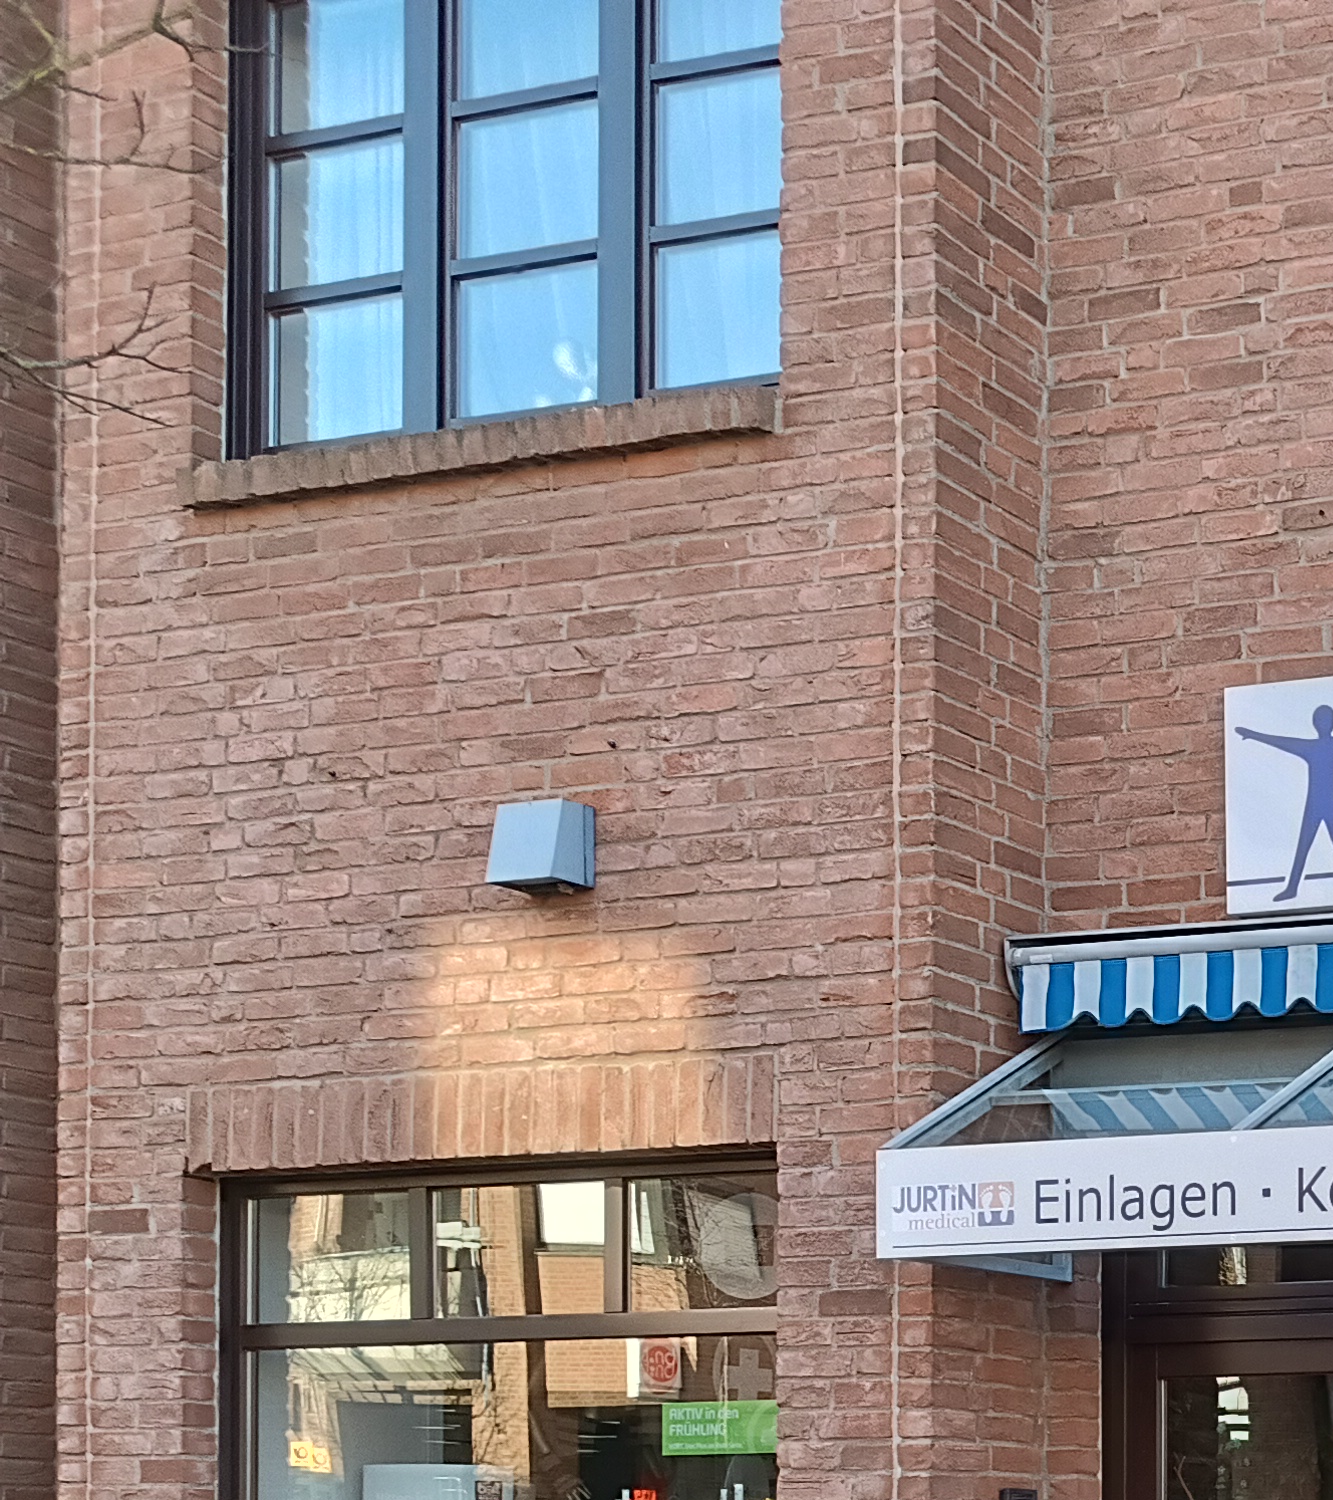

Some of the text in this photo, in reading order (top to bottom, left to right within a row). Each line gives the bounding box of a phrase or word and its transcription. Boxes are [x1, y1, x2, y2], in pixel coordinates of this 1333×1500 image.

[1034, 1176, 1237, 1231] Einlagen
[907, 1213, 977, 1232] medical
[669, 1407, 702, 1420] AKTIV
[705, 1407, 716, 1419] in
[669, 1421, 727, 1436] FRÜHLING
